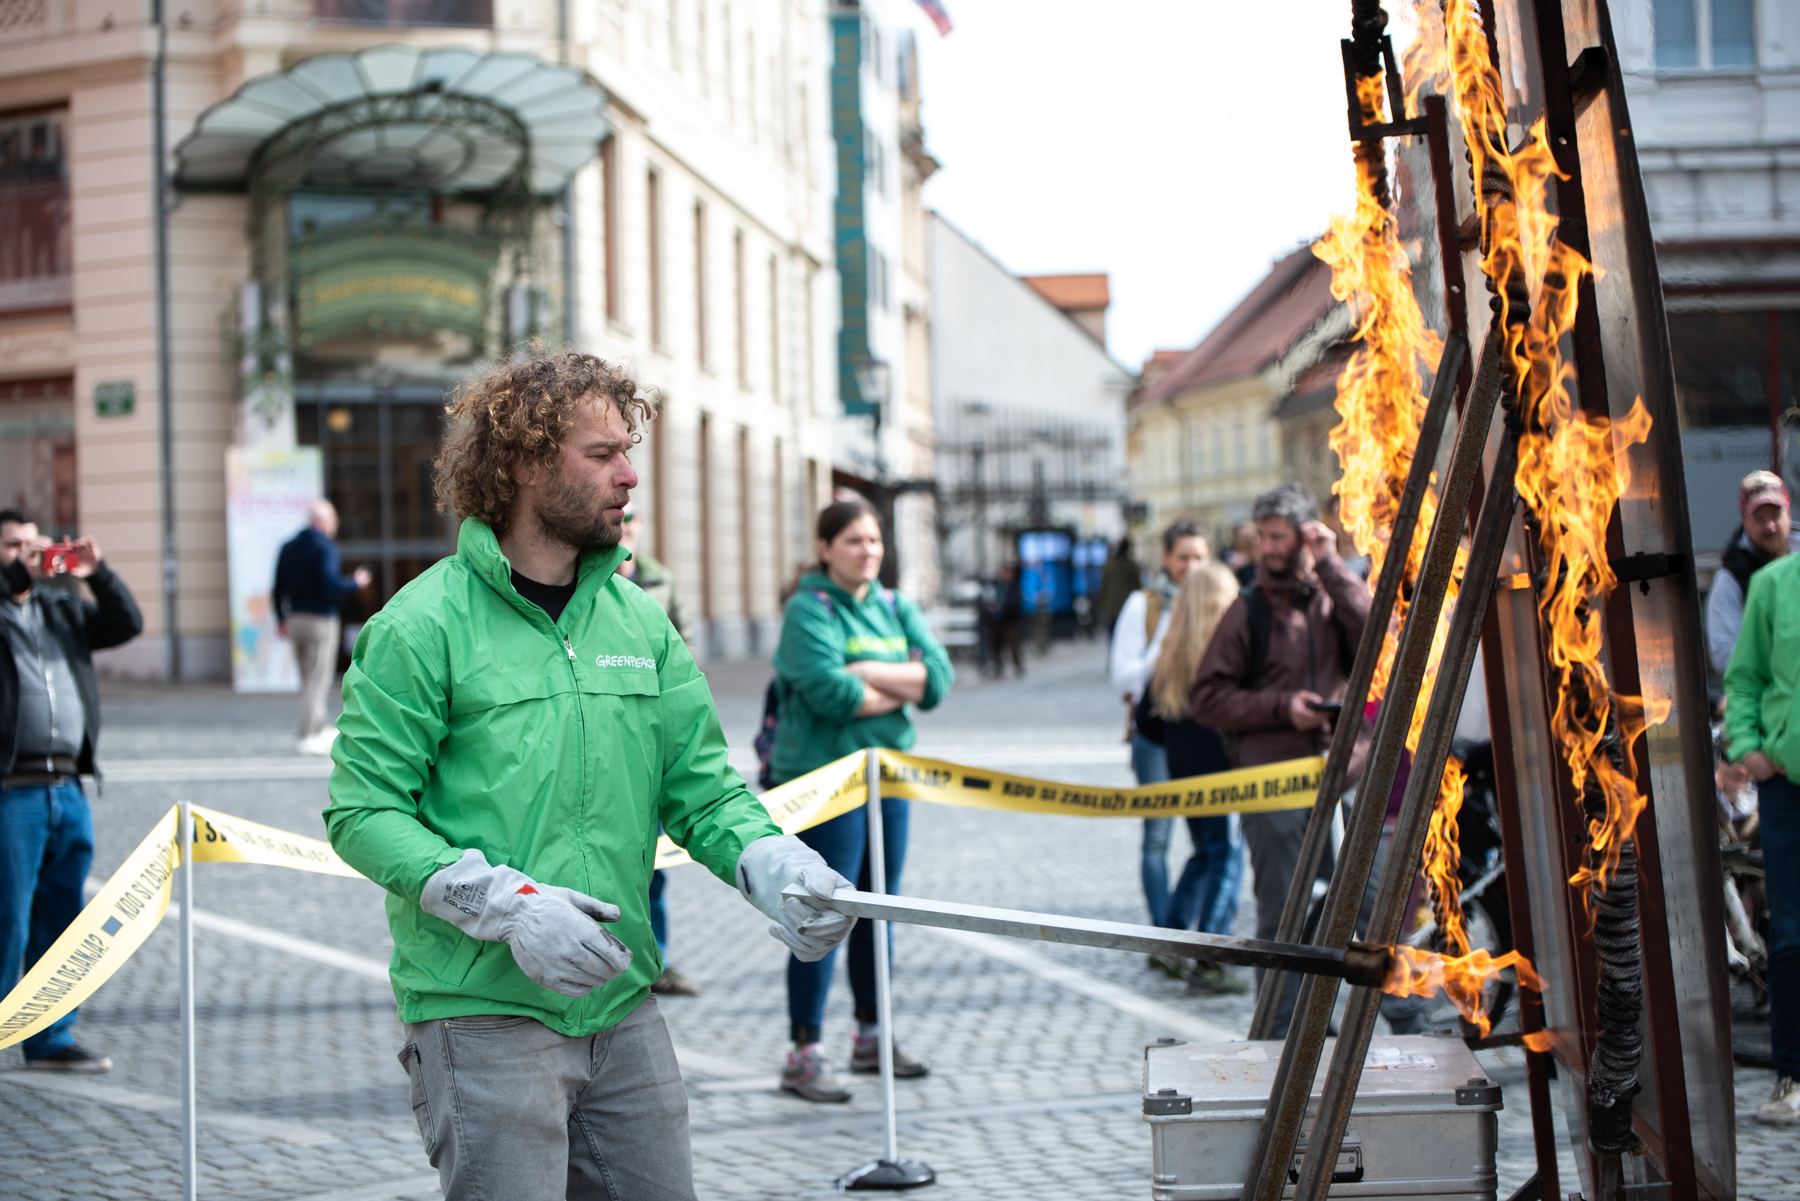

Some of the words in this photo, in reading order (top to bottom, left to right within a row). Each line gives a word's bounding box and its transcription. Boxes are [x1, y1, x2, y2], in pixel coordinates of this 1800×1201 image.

[596, 655, 656, 669] GREENPEACE
[1003, 781, 1036, 799] KDO
[1040, 787, 1057, 801] SI
[1060, 791, 1127, 811] ZASLUŽI
[1131, 792, 1181, 810] KAZEN
[1185, 789, 1204, 807] ZA
[1210, 782, 1258, 805] SVOJA
[1264, 771, 1322, 798] DEJANJ
[131, 880, 155, 900] SI
[114, 891, 146, 921] KDO
[56, 933, 109, 981] DEJANJA?
[32, 976, 77, 1003] SVOJA
[21, 1002, 54, 1012] ZA
